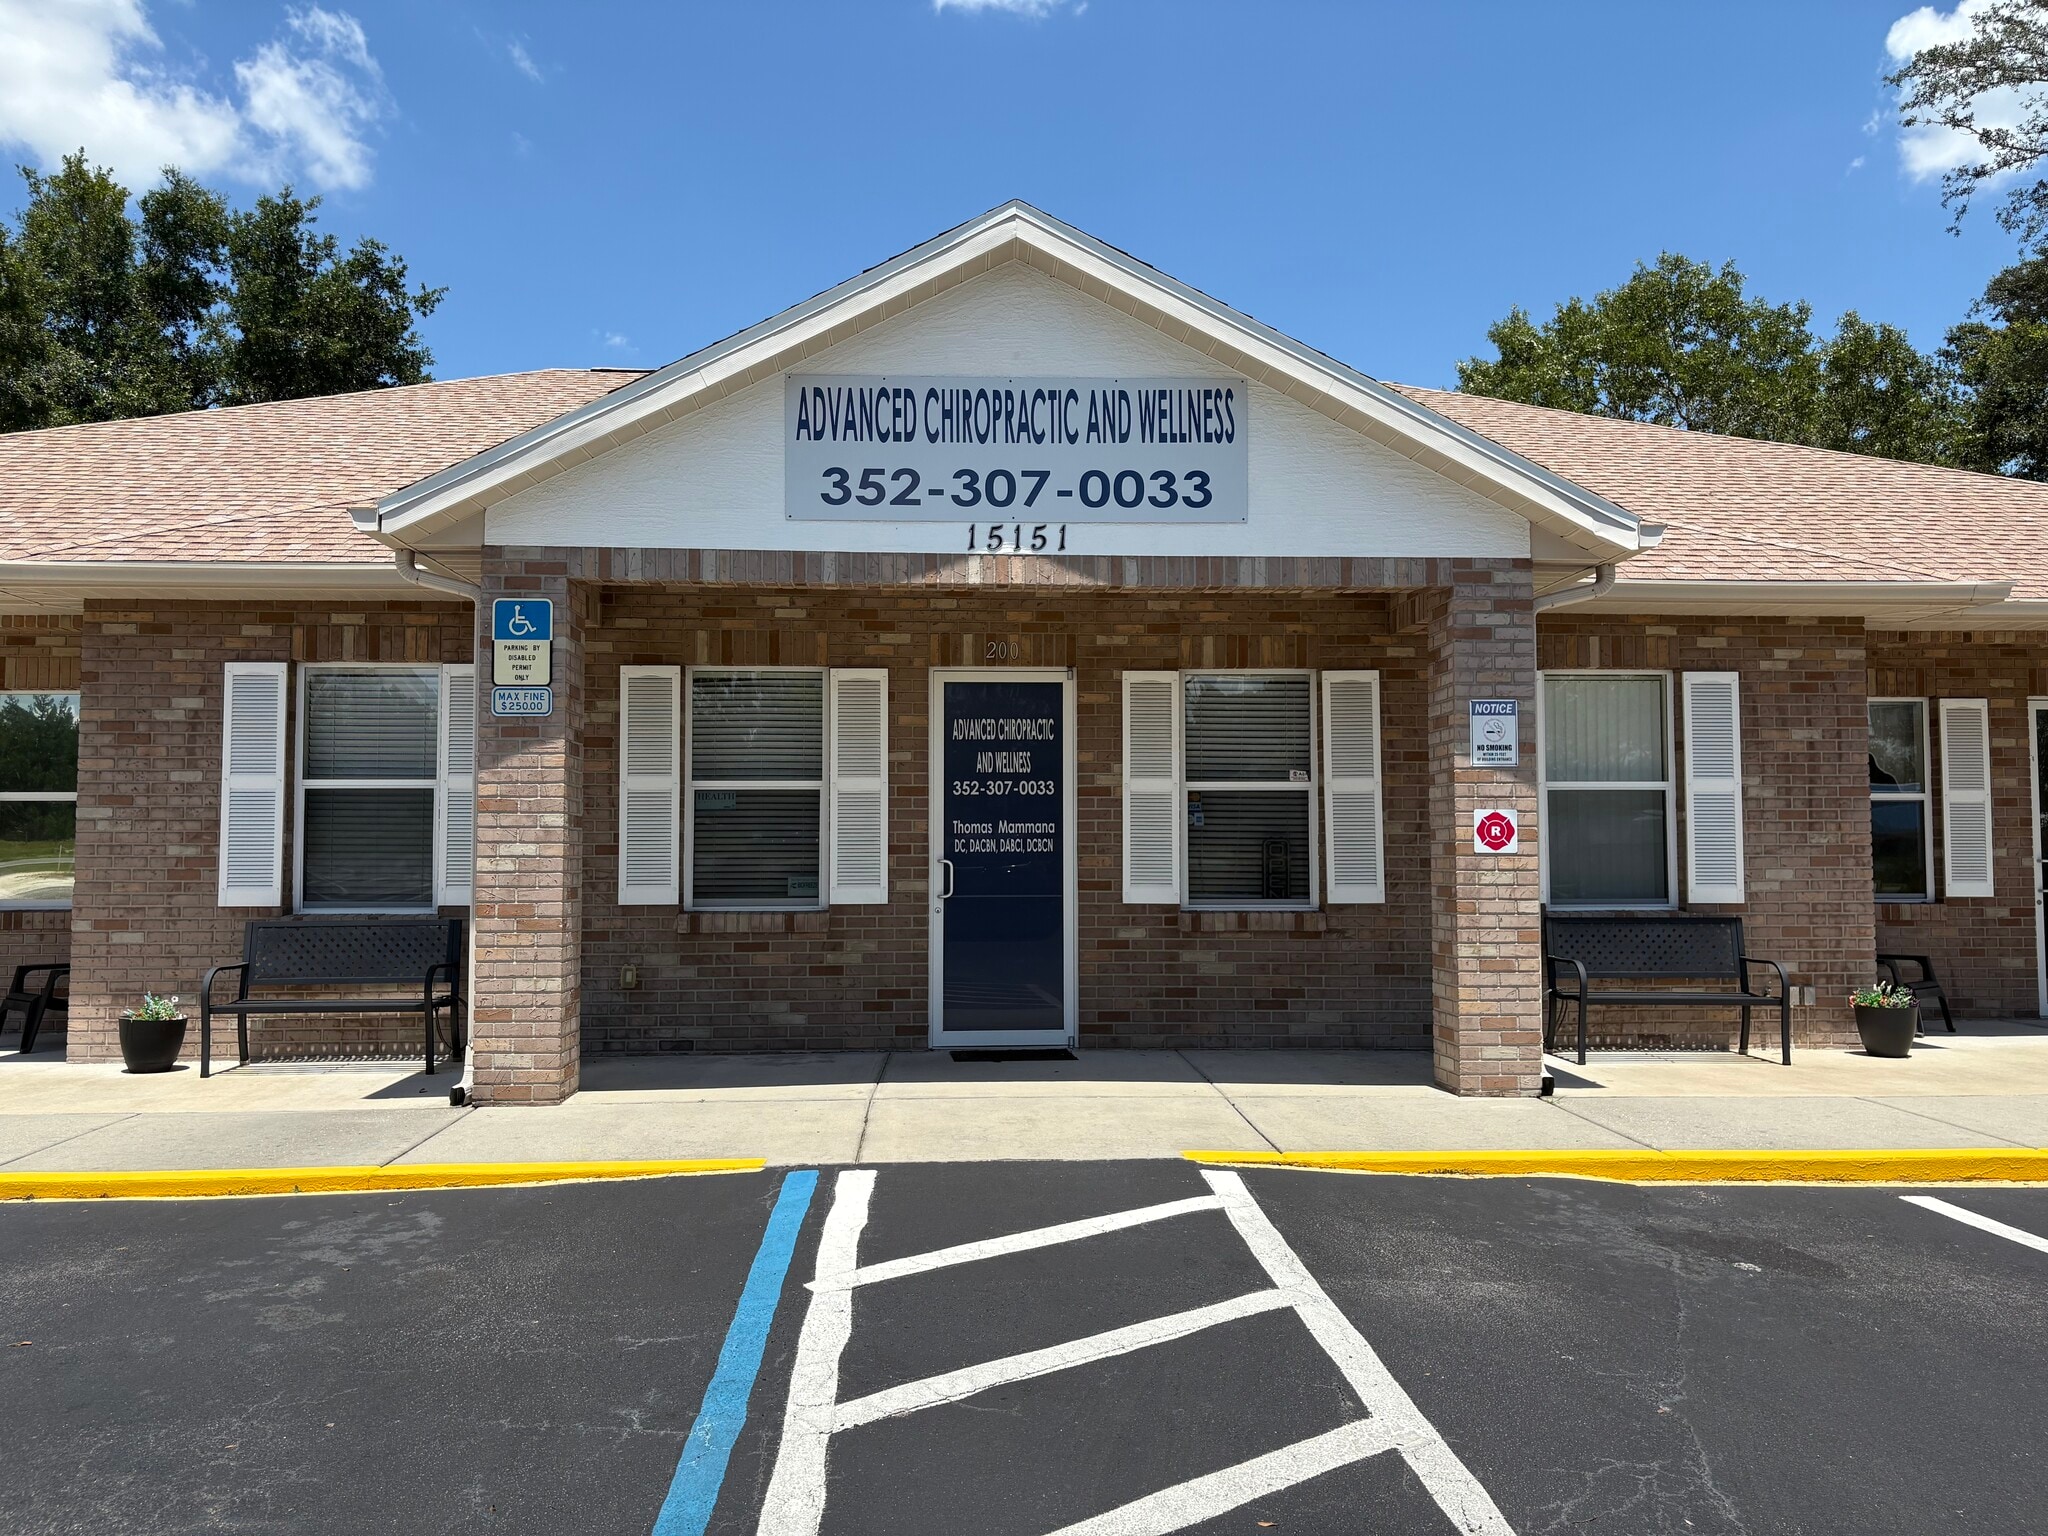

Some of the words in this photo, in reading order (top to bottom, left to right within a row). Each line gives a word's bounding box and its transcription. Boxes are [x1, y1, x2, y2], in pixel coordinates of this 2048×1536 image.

[795, 386, 916, 443] ADVANCED
[924, 387, 1080, 445] CHIROPRACTIC
[1086, 388, 1132, 444] AND
[1138, 387, 1235, 444] WELLNESS
[820, 466, 1214, 508] 352-307-0033
[966, 523, 1067, 552] 15151
[986, 641, 1019, 660] 200
[498, 692, 520, 701] MAX
[523, 692, 545, 701] FINE
[501, 702, 543, 711] $250.00
[1474, 703, 1513, 714] NOTICE
[952, 718, 996, 740] ADVANCED
[998, 718, 1055, 741] CHIROPRACTIC
[1476, 744, 1485, 752] NO
[1486, 744, 1513, 752] SMOKING
[976, 751, 994, 773] AND
[995, 751, 1032, 773] WELLNESS
[952, 781, 1055, 796] 352-307-0033
[697, 792, 735, 801] HEALTH
[952, 820, 993, 834] Thomas
[998, 820, 1055, 834] Mammana
[1490, 825, 1501, 836] R
[954, 839, 968, 854] DC,
[970, 839, 998, 854] DACBN,
[1000, 839, 1025, 854] DABCI,
[1026, 838, 1054, 852] DCBCN
[1268, 844, 1287, 898] OPEN
